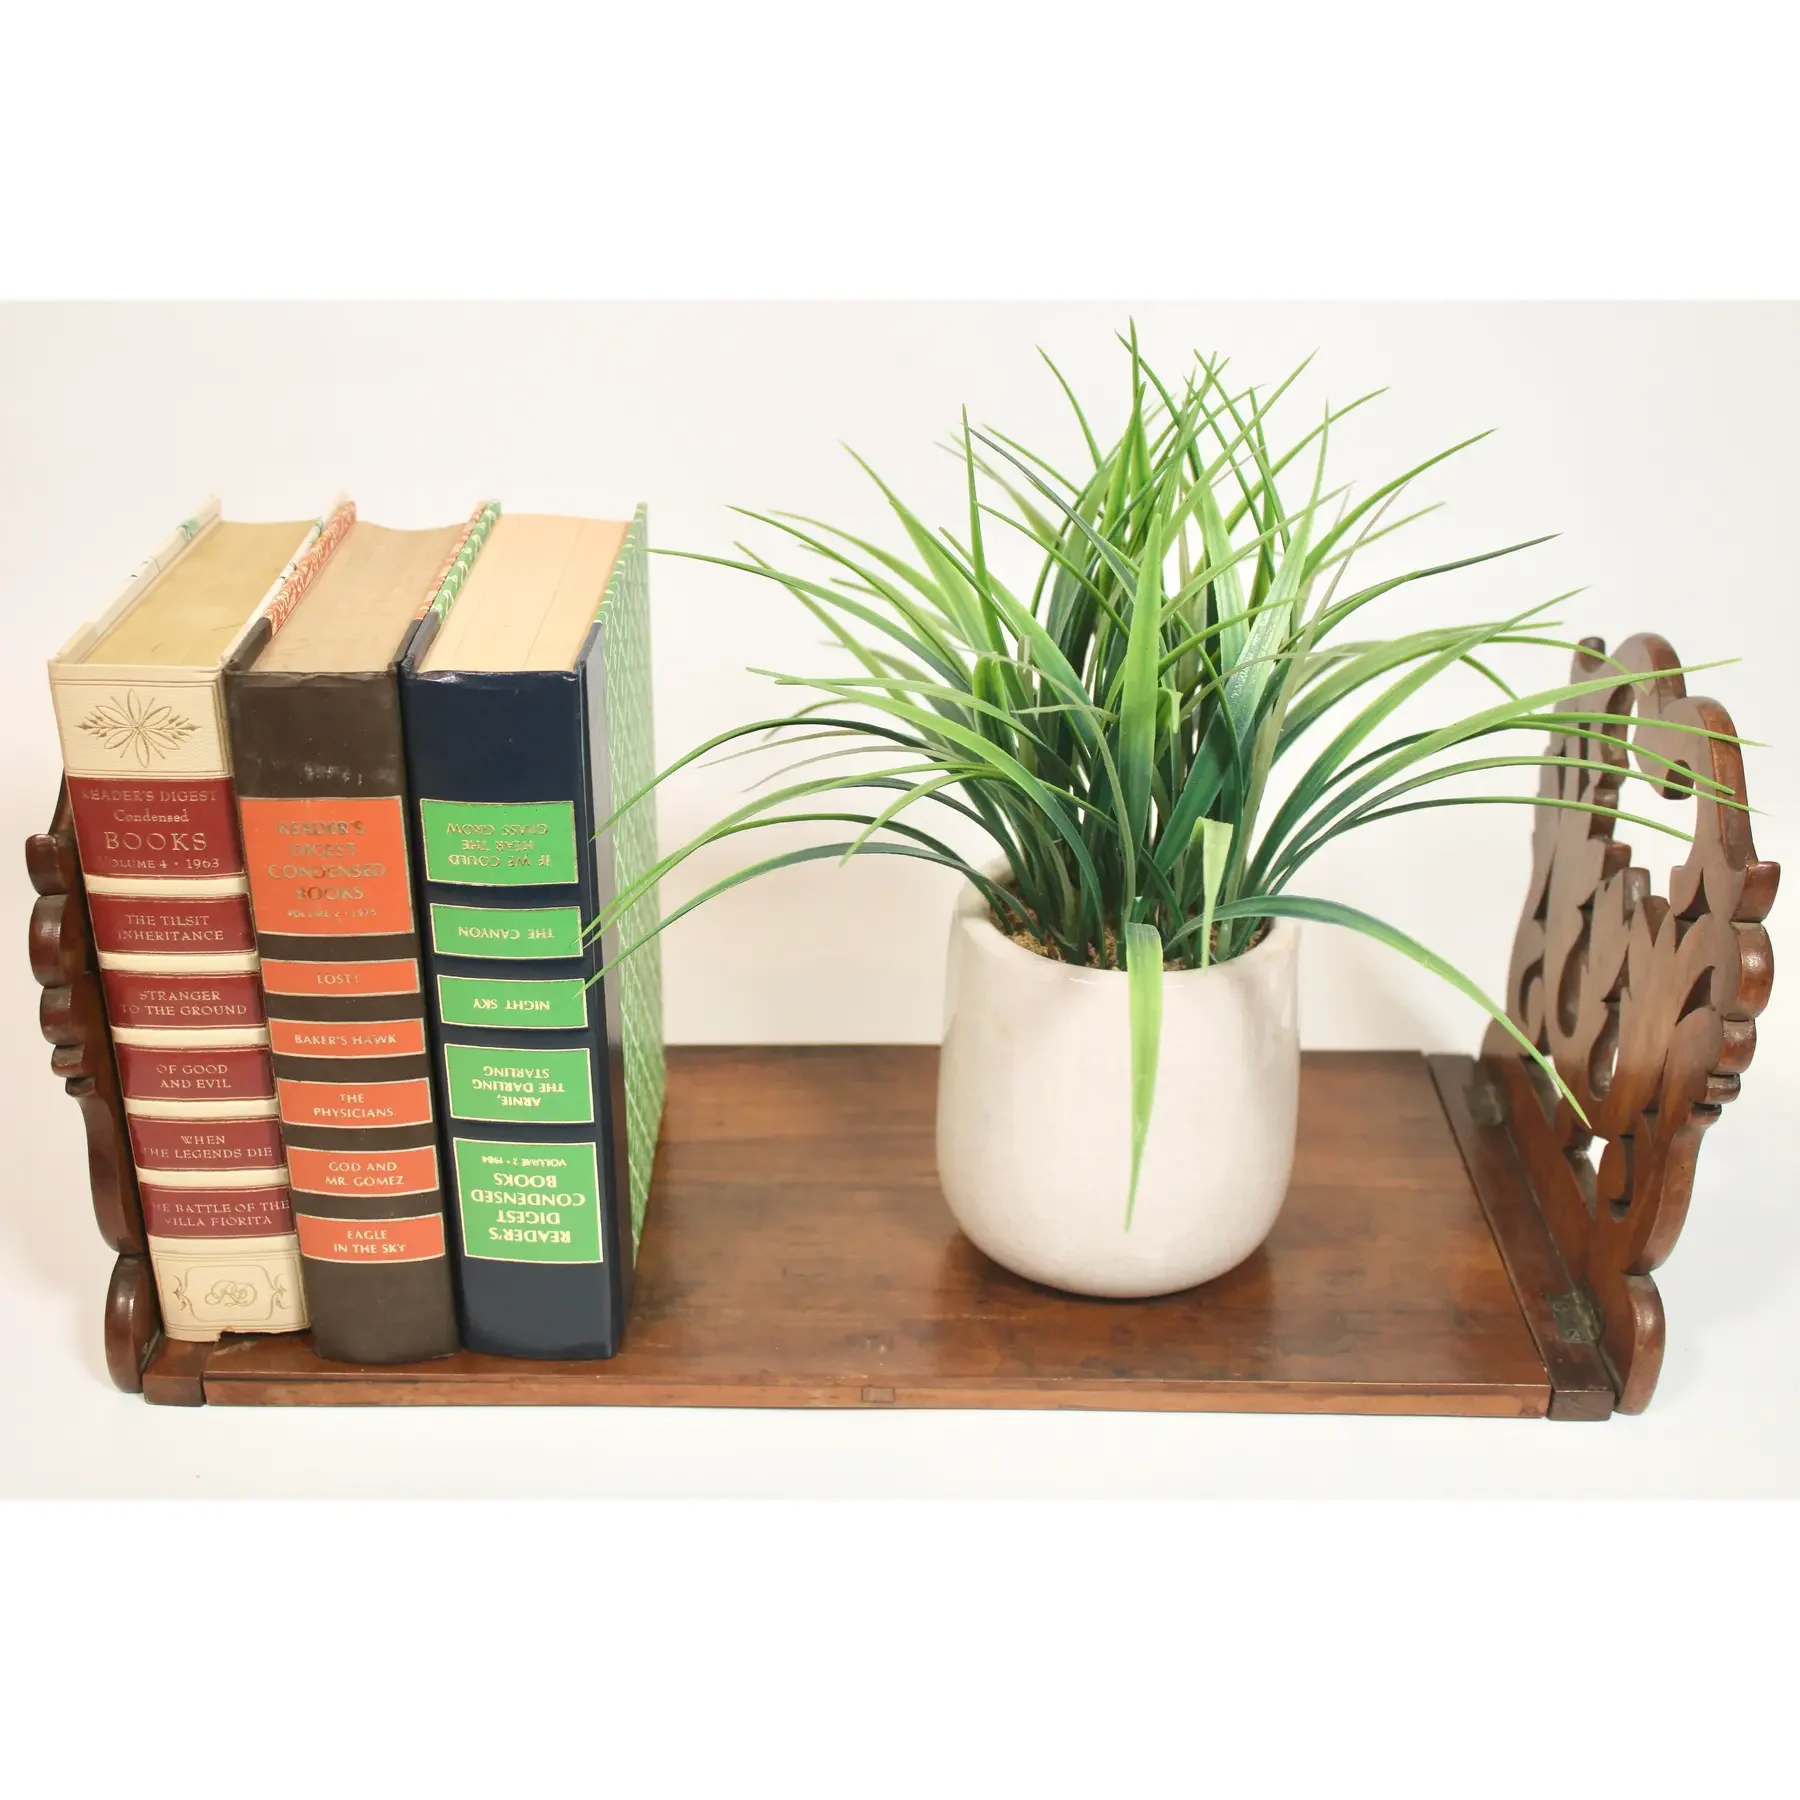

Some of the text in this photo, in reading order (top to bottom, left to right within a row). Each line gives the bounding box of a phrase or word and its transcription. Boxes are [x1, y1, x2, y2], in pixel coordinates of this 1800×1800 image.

[160, 791, 217, 801] DIGEST
[114, 809, 190, 822] Condensed
[277, 821, 364, 835] READER'S
[446, 823, 494, 836] GROW
[105, 832, 207, 850] BOOKS
[462, 839, 534, 851] HEAR THE
[289, 842, 355, 857] DIGEST
[98, 857, 219, 869] OLUME 4 1963
[448, 854, 551, 867] IF WE COULD
[268, 863, 386, 879] CONDENSED
[296, 886, 364, 901] BOOKS
[126, 915, 209, 926] THE TILSIT
[119, 930, 224, 941] INHERITANCE
[458, 926, 555, 939] THE CANYON
[317, 974, 359, 984] LOST!
[140, 990, 220, 1000] STRANGER
[120, 1004, 247, 1016] TO THE GROUND
[473, 998, 550, 1010] NIGHT SKY
[295, 1034, 397, 1045] BAKER'S HAWK
[156, 1064, 228, 1074] OF GOOD
[483, 1065, 549, 1079] STARLING
[160, 1079, 231, 1088] AND EVIL
[472, 1079, 565, 1093] THE DARLING
[340, 1093, 364, 1103] THE
[497, 1094, 542, 1106] ARNIE,
[314, 1108, 393, 1118] PHYSICIANS
[181, 1135, 225, 1145] WHEN
[175, 1148, 242, 1159] LEGENDS
[247, 1147, 272, 1157] DIE
[329, 1161, 397, 1172] GOD AND
[521, 1158, 567, 1167] VOLUME
[325, 1176, 404, 1186] MR. GOMEZ
[494, 1172, 557, 1188] BOOKS
[471, 1189, 585, 1207] CONDENSED
[152, 1201, 290, 1213] HE BATTLE OF THE
[165, 1215, 272, 1226] VILLA FIORITA
[497, 1210, 560, 1225] DIGEST
[347, 1230, 388, 1240] EAGLE
[489, 1227, 571, 1244] READER'S
[334, 1243, 408, 1253] IN THE SKY
